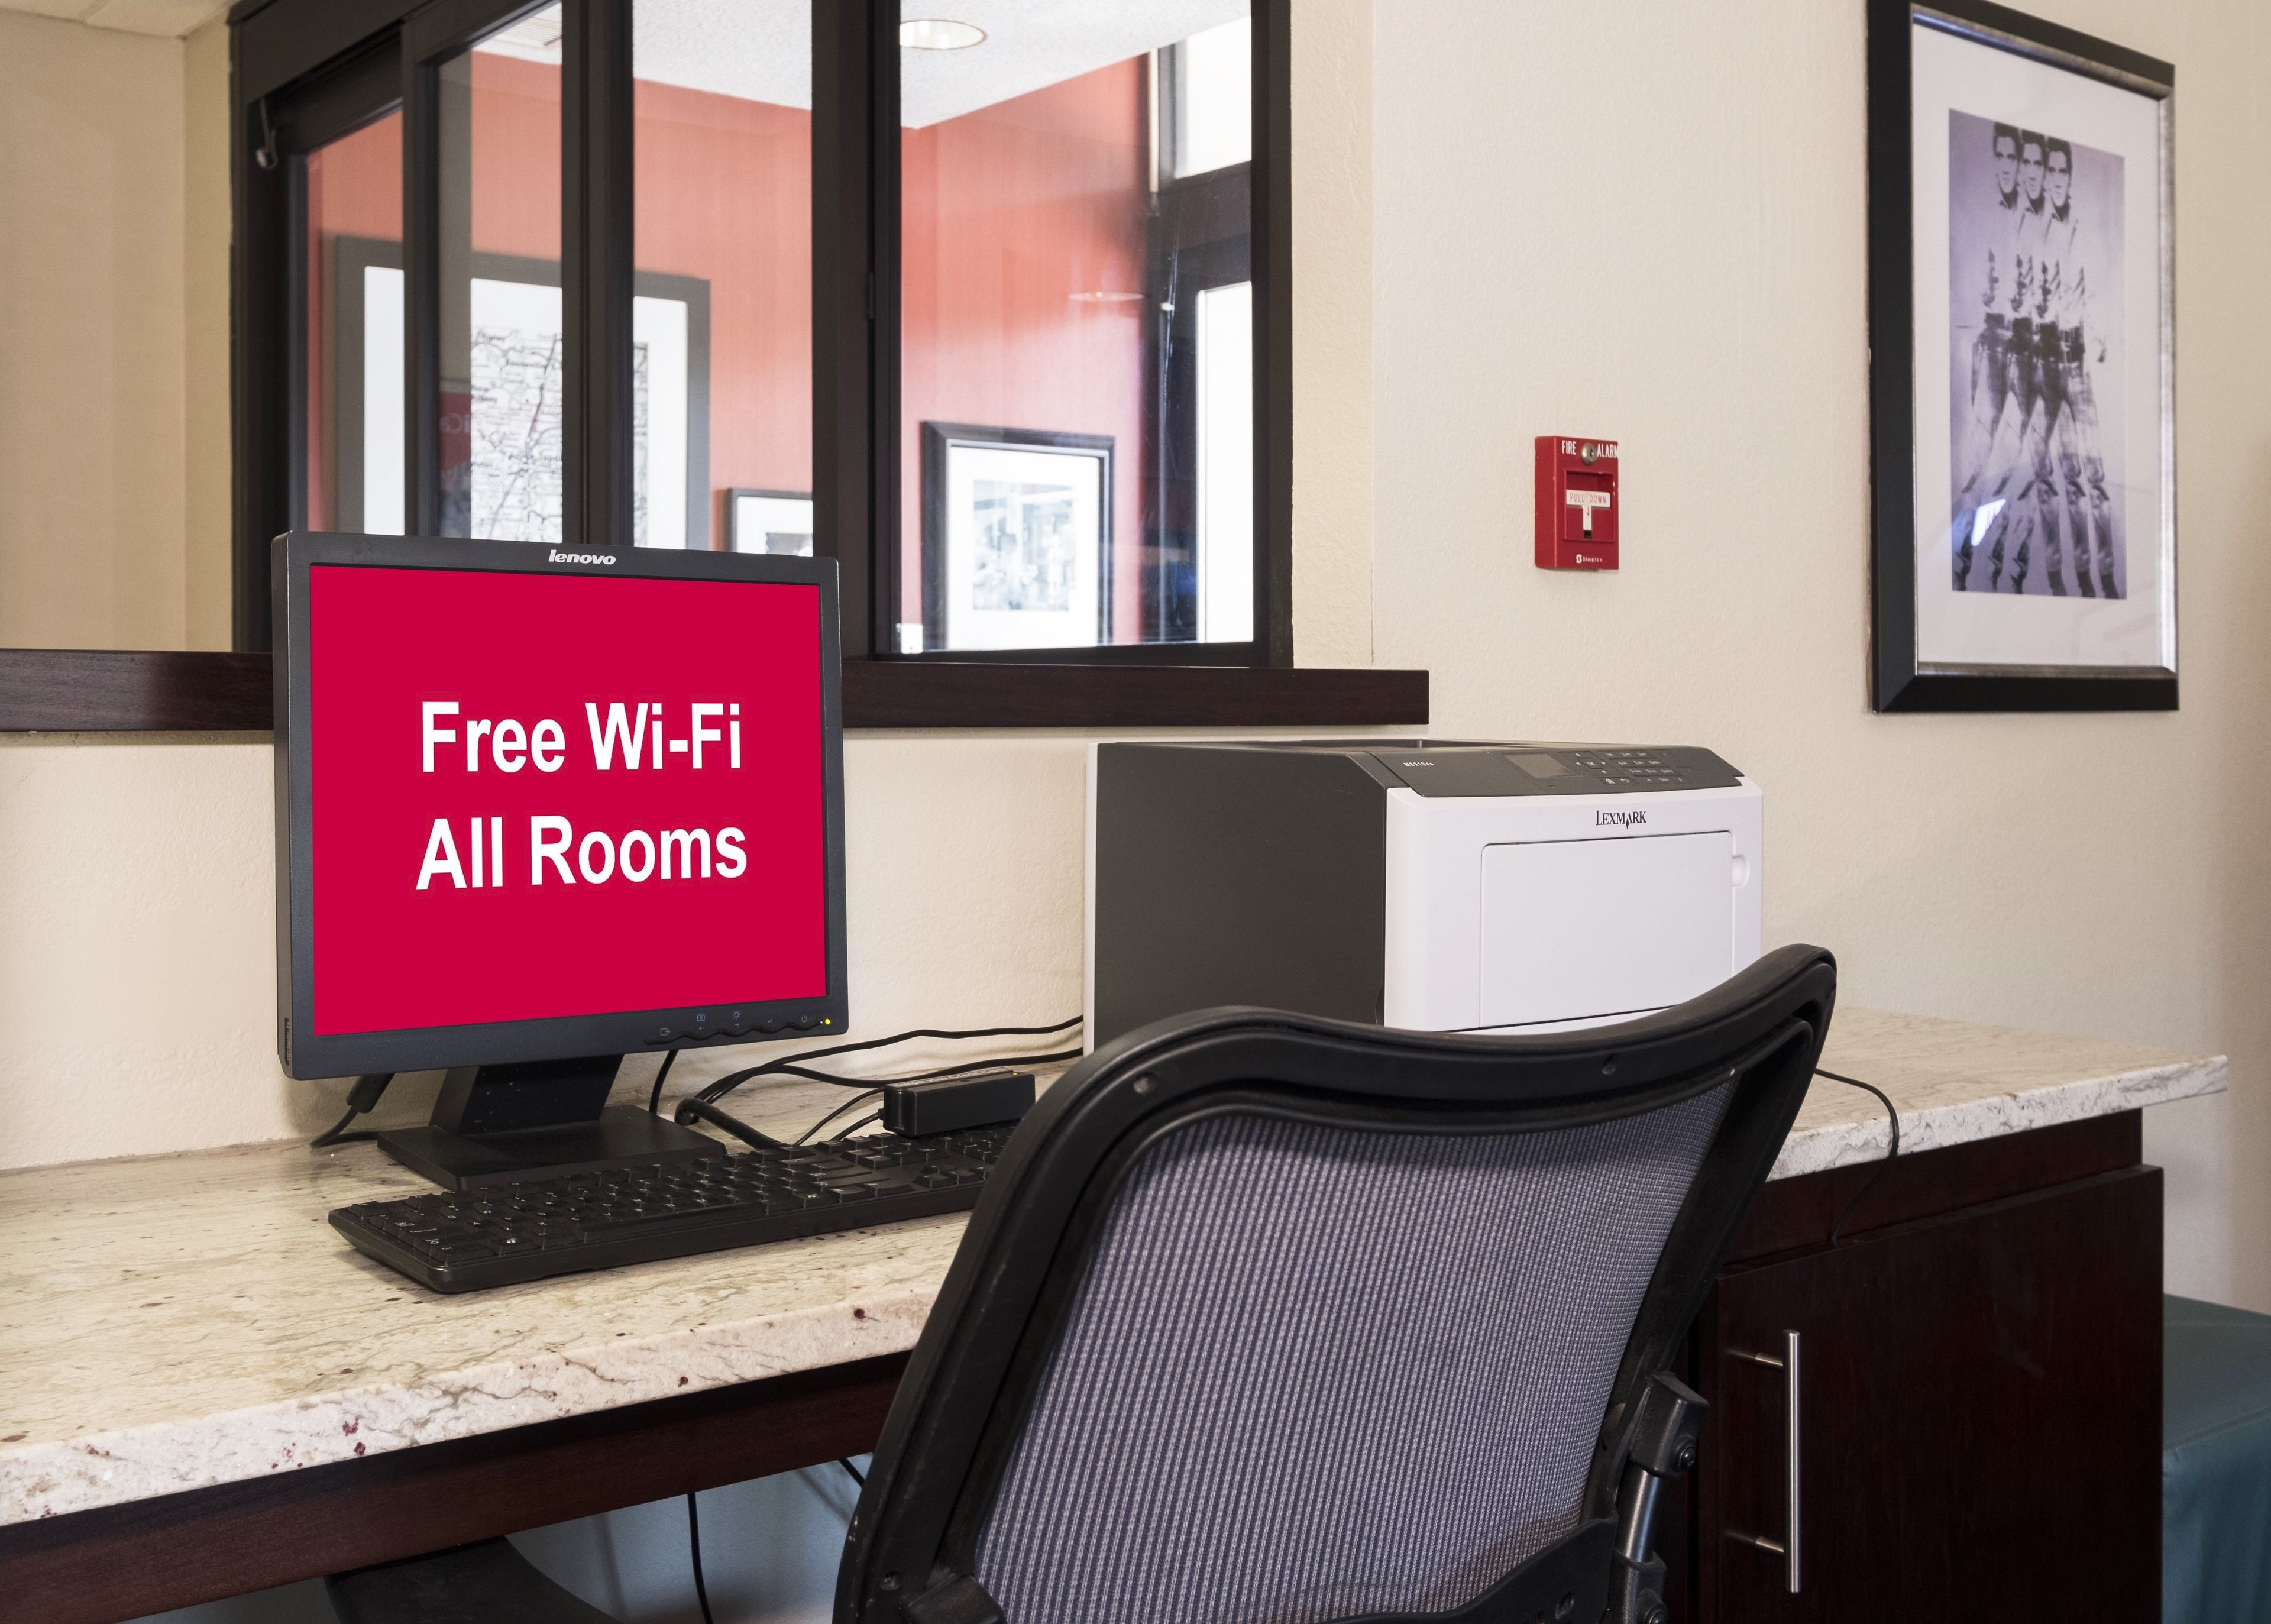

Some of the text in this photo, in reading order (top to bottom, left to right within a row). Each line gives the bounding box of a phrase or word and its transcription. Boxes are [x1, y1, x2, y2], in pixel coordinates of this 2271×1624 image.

[1562, 441, 1576, 455] FIRE
[1570, 493, 1606, 504] PULL DOWN
[549, 549, 616, 565] lenovo
[423, 702, 740, 772] Free Wi-Fi
[416, 816, 746, 890] All Rooms
